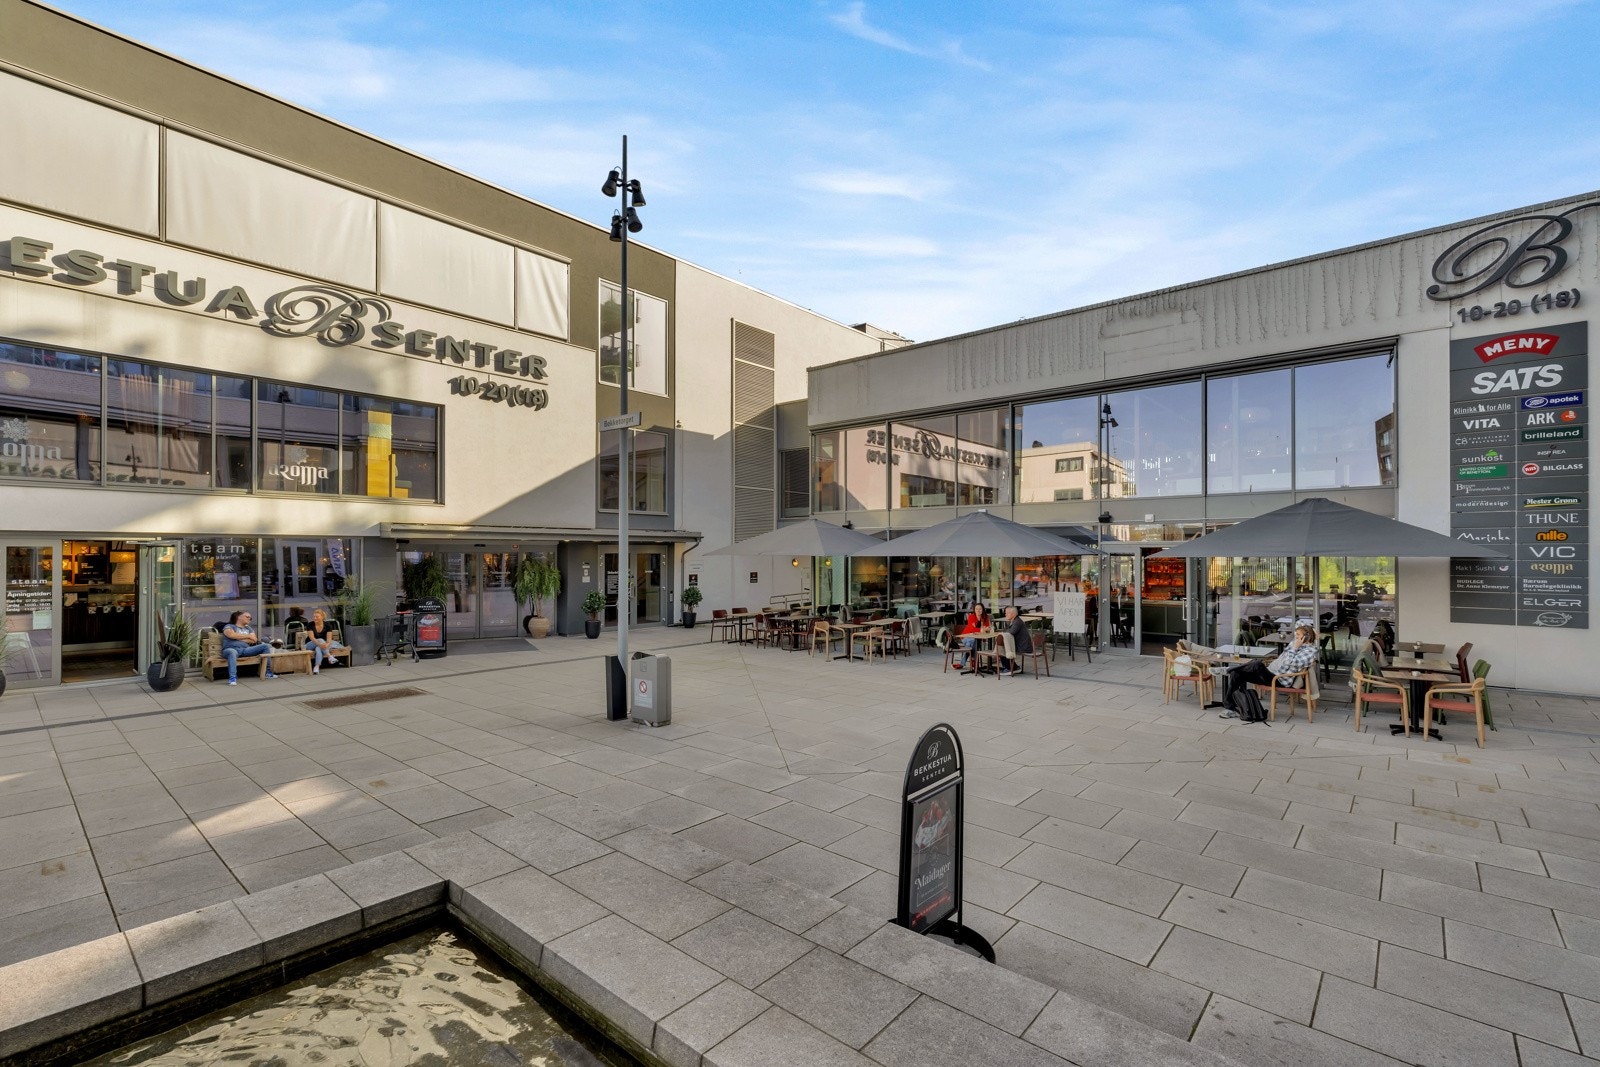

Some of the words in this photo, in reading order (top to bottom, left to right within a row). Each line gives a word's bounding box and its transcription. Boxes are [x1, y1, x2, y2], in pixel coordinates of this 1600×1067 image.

[10, 236, 259, 318] ESTUA
[376, 321, 549, 380] SENTER
[1457, 299, 1522, 323] 10-20
[1530, 288, 1581, 314] (18)
[1483, 337, 1551, 357] MENY
[1470, 364, 1564, 395] SATS
[1549, 396, 1579, 404] apotek
[1497, 402, 1511, 411] Alle
[1462, 417, 1501, 430] VITA
[1526, 411, 1556, 426] ARK
[1524, 430, 1580, 440] brilleland
[1462, 454, 1503, 463] sunkost
[1542, 464, 1583, 472] BILGLASS
[1525, 512, 1579, 524] THUNE
[1536, 529, 1568, 541] nille
[1529, 546, 1576, 558] VIC
[1523, 598, 1582, 607] ELGER
[913, 754, 952, 777] BEKKESTUA
[922, 767, 945, 782] SENTER
